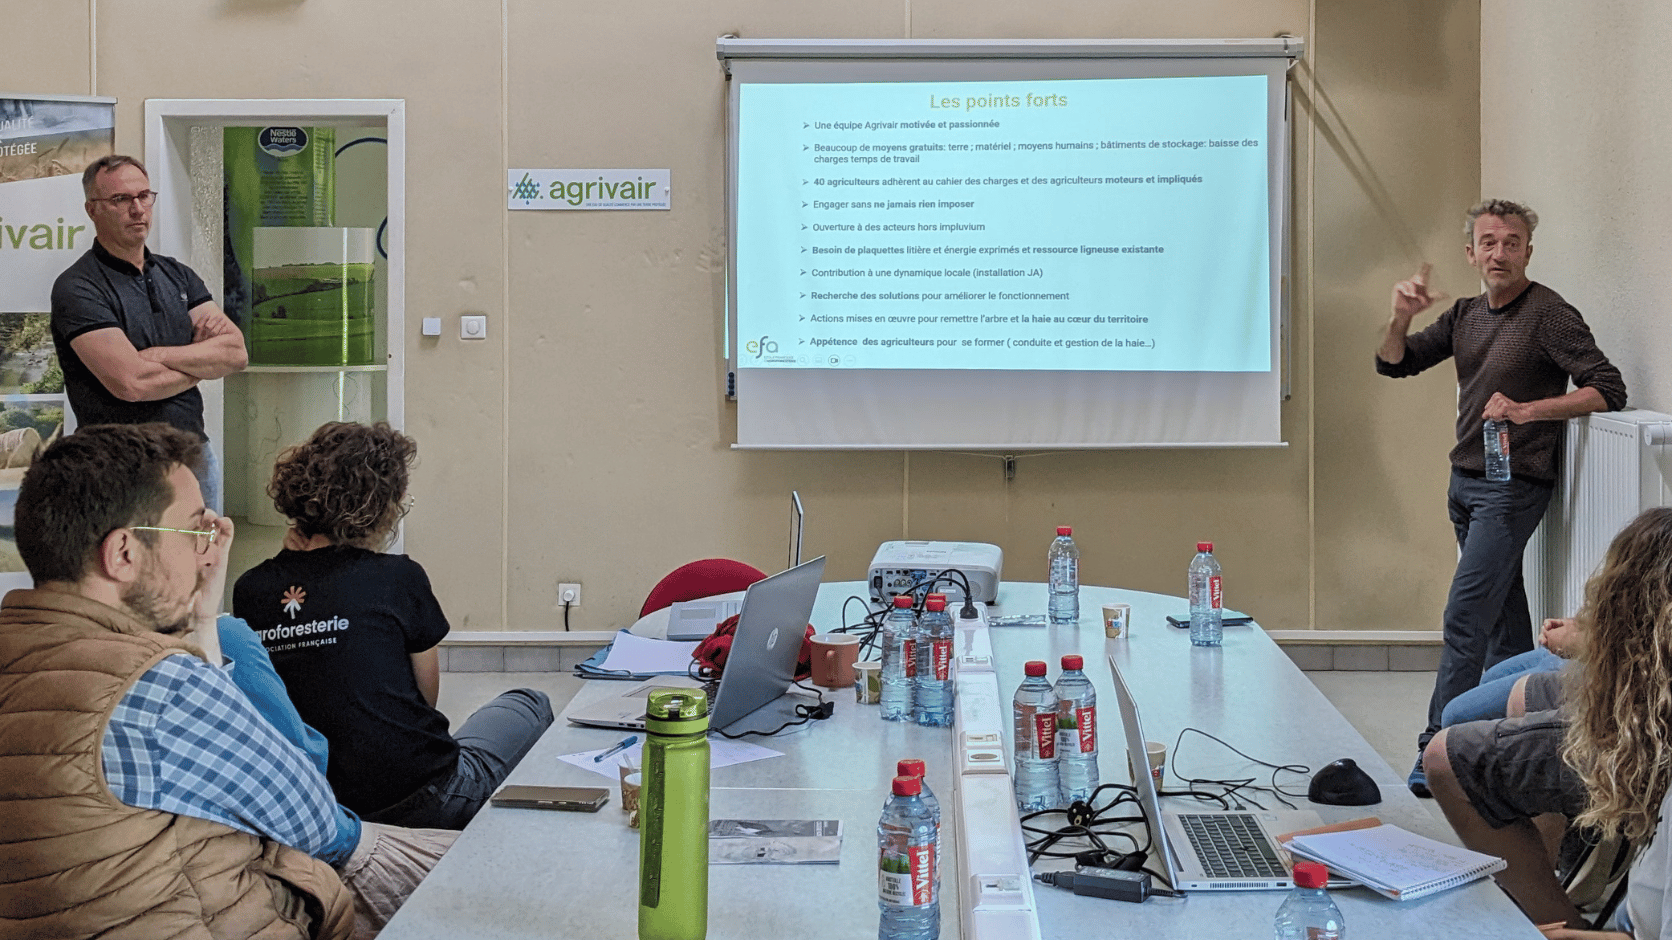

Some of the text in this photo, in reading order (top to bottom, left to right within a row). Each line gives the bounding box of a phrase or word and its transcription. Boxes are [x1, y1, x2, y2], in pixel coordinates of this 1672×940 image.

[930, 92, 1068, 112] Les points forts
[833, 121, 862, 131] équipe
[864, 121, 898, 131] Agrivair
[900, 120, 936, 128] motivée
[949, 119, 1000, 130] passionnée
[814, 143, 857, 154] Beaucoup
[872, 145, 907, 154] moyens
[909, 142, 945, 153] gratuits:
[975, 142, 1011, 150] matériel
[1018, 143, 1053, 151] moyens
[1148, 140, 1160, 148] de
[1162, 139, 1206, 149] stockage:
[1208, 139, 1239, 147] baisse
[1241, 138, 1258, 146] des
[814, 155, 920, 164] charges temps de travail
[827, 177, 880, 187] agriculteurs
[982, 176, 1018, 186] charges
[1050, 176, 1103, 186] agriculteurs
[1157, 174, 1202, 184] impliqués
[550, 176, 656, 206] agrivair
[813, 200, 849, 210] Engager
[886, 200, 916, 210] jamais
[918, 199, 936, 208] rien
[938, 199, 974, 209] imposer
[857, 223, 862, 231] à
[918, 223, 937, 231] hors
[939, 222, 985, 232] impluvium
[812, 245, 842, 254] Besoin
[844, 246, 856, 254] de
[857, 246, 904, 256] plaquettes
[906, 245, 931, 254] litière
[944, 245, 976, 256] énergie
[978, 245, 1020, 255] exprimés
[1080, 245, 1119, 255] ligneuse
[1121, 245, 1164, 253] existante
[811, 268, 865, 276] Contribution
[893, 268, 942, 278] dynamique
[944, 268, 970, 276] locale
[972, 268, 1025, 278] (installation
[1027, 268, 1043, 278] JA)
[811, 291, 858, 299] Recherche
[878, 291, 920, 299] solutions
[922, 293, 942, 301] pour
[944, 291, 986, 299] améliorer
[988, 291, 996, 299] le
[998, 292, 1069, 300] fonctionnement
[810, 314, 844, 322] Actions
[846, 314, 872, 322] mises
[918, 316, 938, 324] pour
[1021, 314, 1030, 322] la
[1032, 314, 1051, 322] haie
[1093, 315, 1105, 323] du
[1107, 315, 1148, 323] territoire
[746, 336, 778, 359] efa
[810, 337, 858, 347] Appétence
[862, 337, 878, 345] des
[880, 338, 934, 348] agriculteurs
[936, 339, 957, 347] pour
[974, 338, 1004, 346] former
[1012, 338, 1052, 346] conduite
[1065, 339, 1099, 348] gestion
[1101, 338, 1112, 346] de
[1115, 338, 1123, 347] la
[298, 637, 337, 647] FRANÇAISE
[908, 643, 916, 667] Vittel
[938, 645, 947, 671] Vittel
[1082, 711, 1092, 741] Vittel
[1042, 717, 1052, 748] Vittel
[916, 850, 929, 890] Vittel
